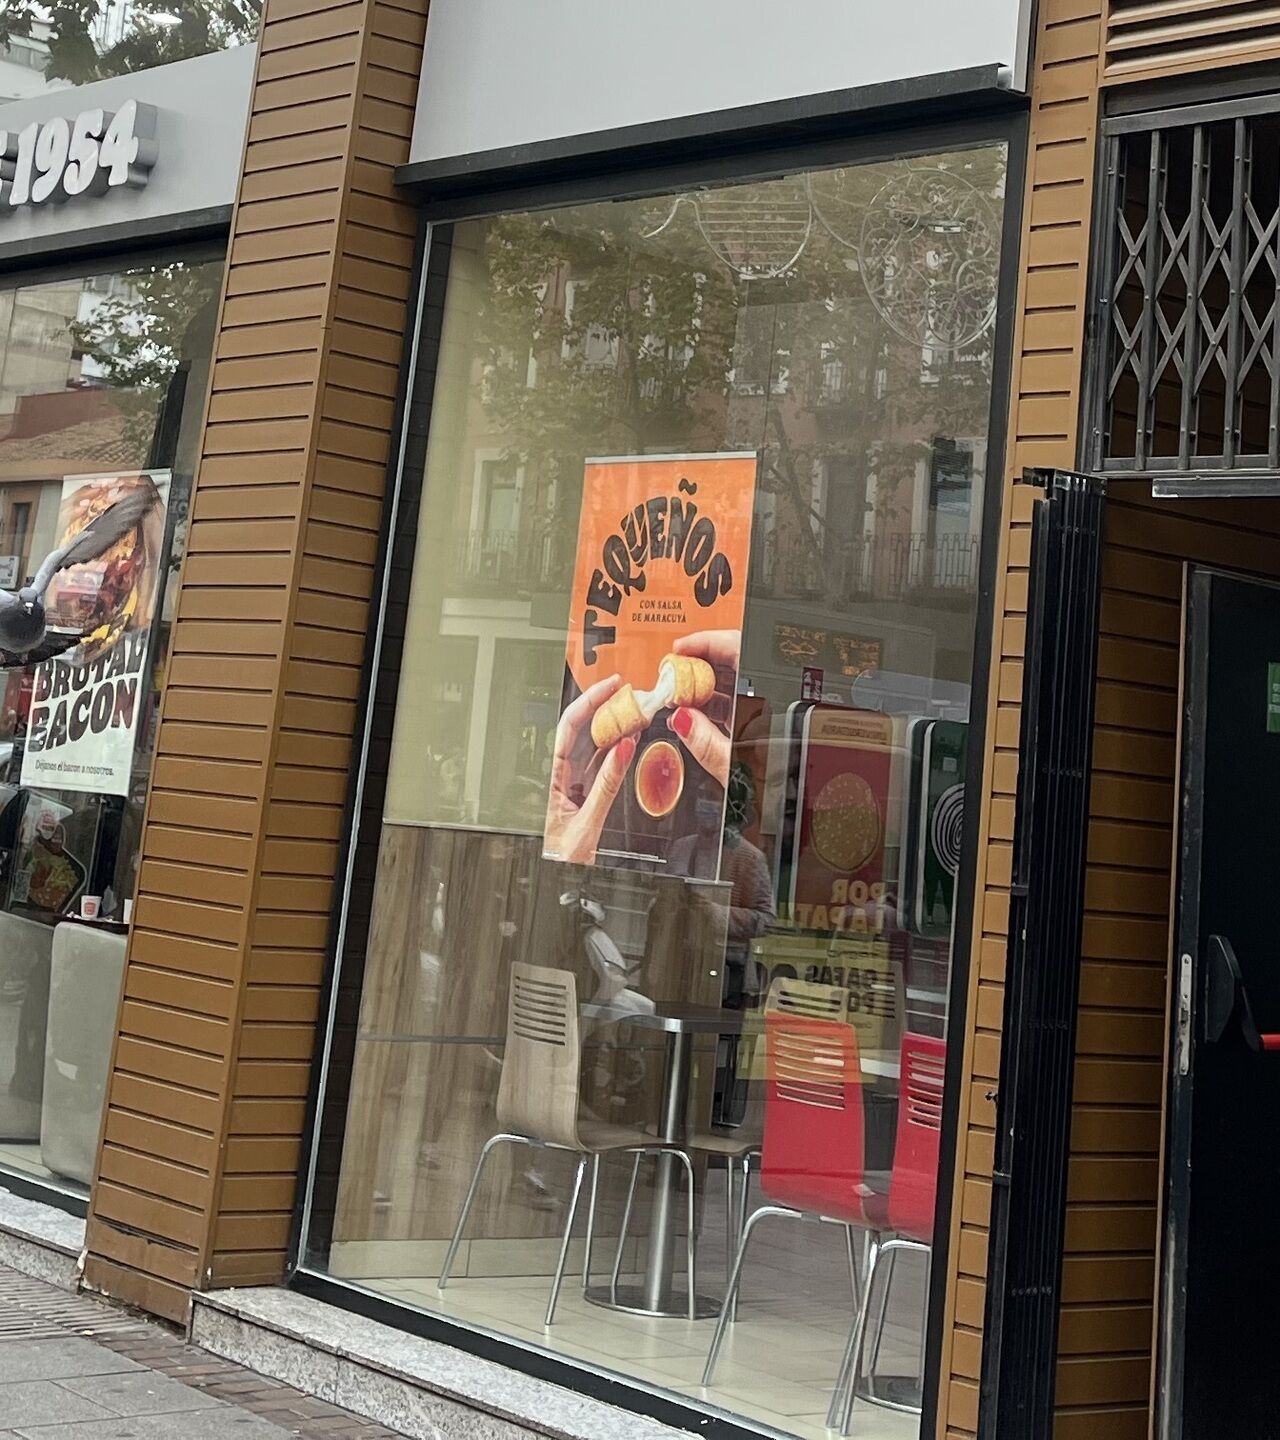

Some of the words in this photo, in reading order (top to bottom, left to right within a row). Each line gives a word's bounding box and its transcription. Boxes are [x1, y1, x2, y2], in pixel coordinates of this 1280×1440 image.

[10, 99, 139, 206] 1954
[583, 478, 733, 667] TEQUEÑOS
[639, 599, 656, 610] CON
[657, 599, 683, 610] SALSA
[631, 613, 642, 623] DE
[33, 631, 147, 703] BRUTAL
[28, 678, 138, 753] BACON
